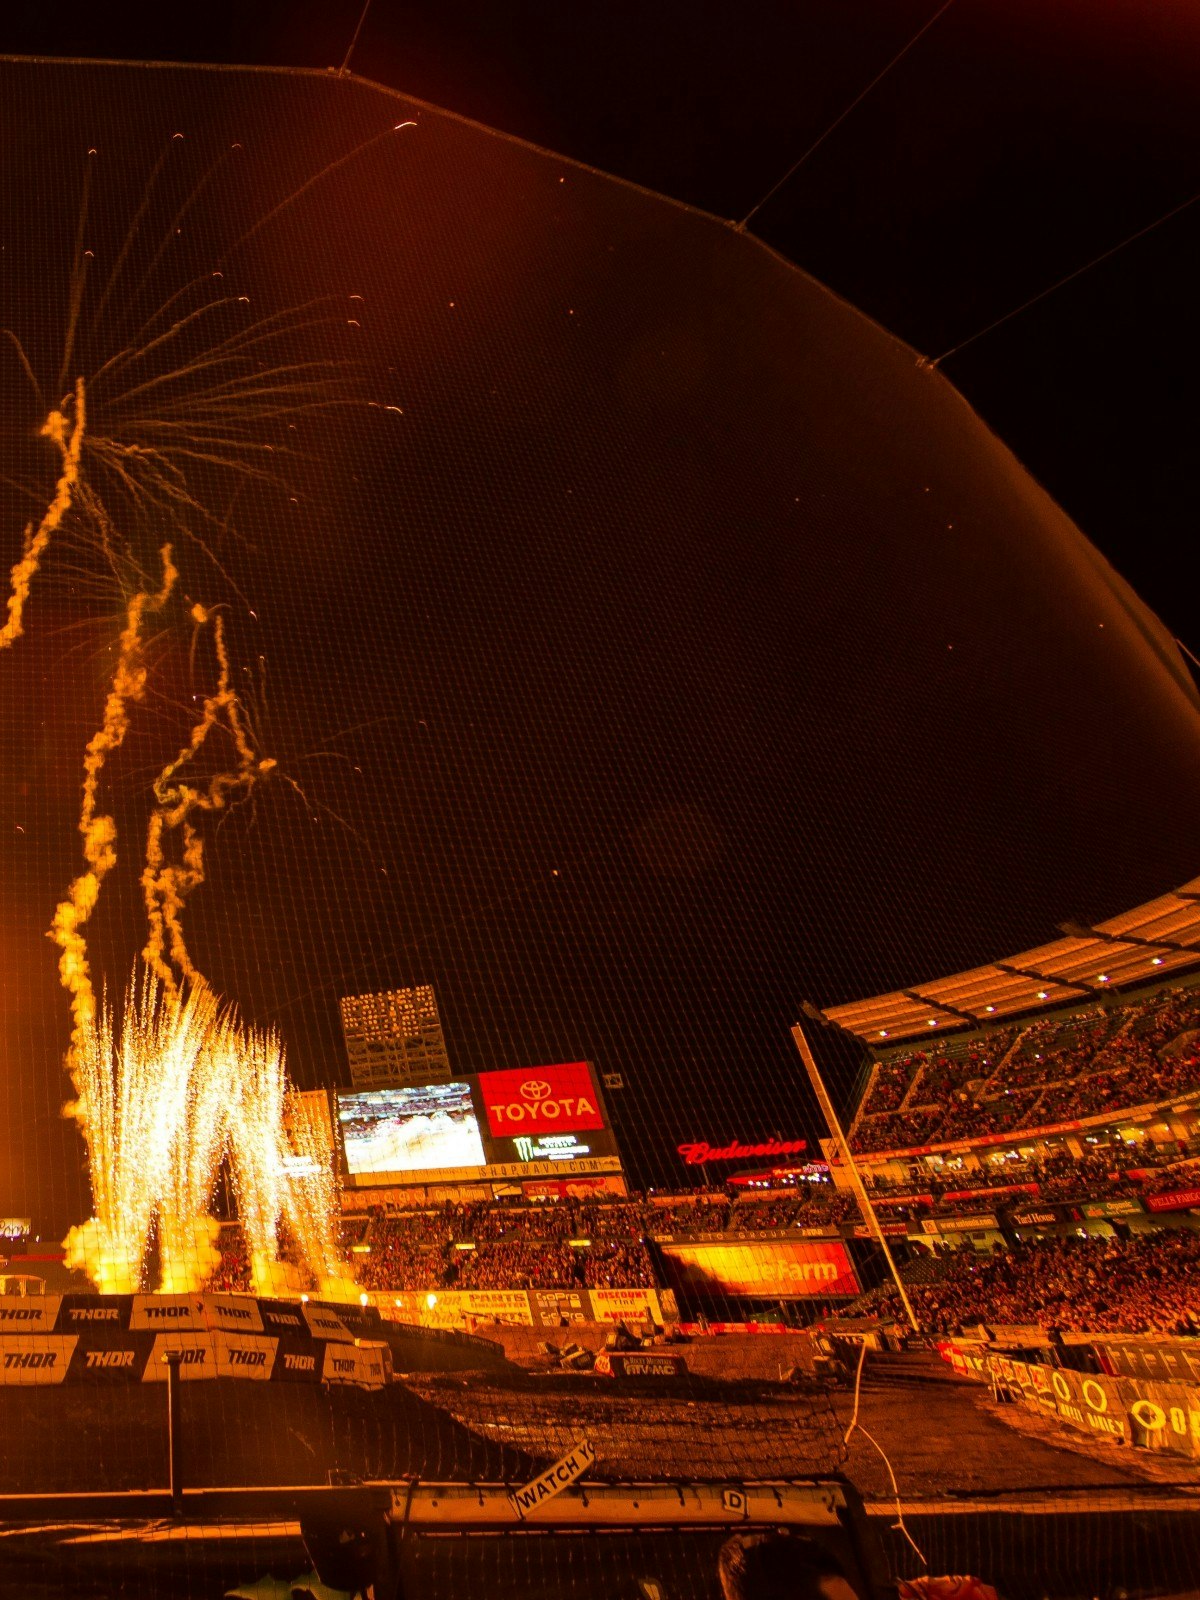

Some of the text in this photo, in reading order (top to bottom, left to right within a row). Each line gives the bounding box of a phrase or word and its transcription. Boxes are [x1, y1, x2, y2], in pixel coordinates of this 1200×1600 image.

[490, 1097, 596, 1123] TOYOTA
[677, 1138, 807, 1164] Budweiser
[1149, 1195, 1177, 1207] WELLS
[1014, 1212, 1056, 1225] Yard House
[738, 1230, 787, 1240] GROUP
[469, 1293, 526, 1302] PARTS
[536, 1292, 580, 1301] GoPro
[597, 1291, 648, 1299] DISCOUNT
[69, 1308, 119, 1320] THOR
[144, 1306, 191, 1318] THOR
[215, 1305, 252, 1319] THOR
[266, 1312, 301, 1326] THOR
[314, 1319, 343, 1330] THOR
[4, 1352, 59, 1369] THOR
[85, 1351, 135, 1368] THOR
[228, 1349, 267, 1366] THOR
[283, 1354, 316, 1371] THOR
[332, 1358, 356, 1373] THOR
[518, 1455, 580, 1509] WATCH
[730, 1493, 742, 1508] D
